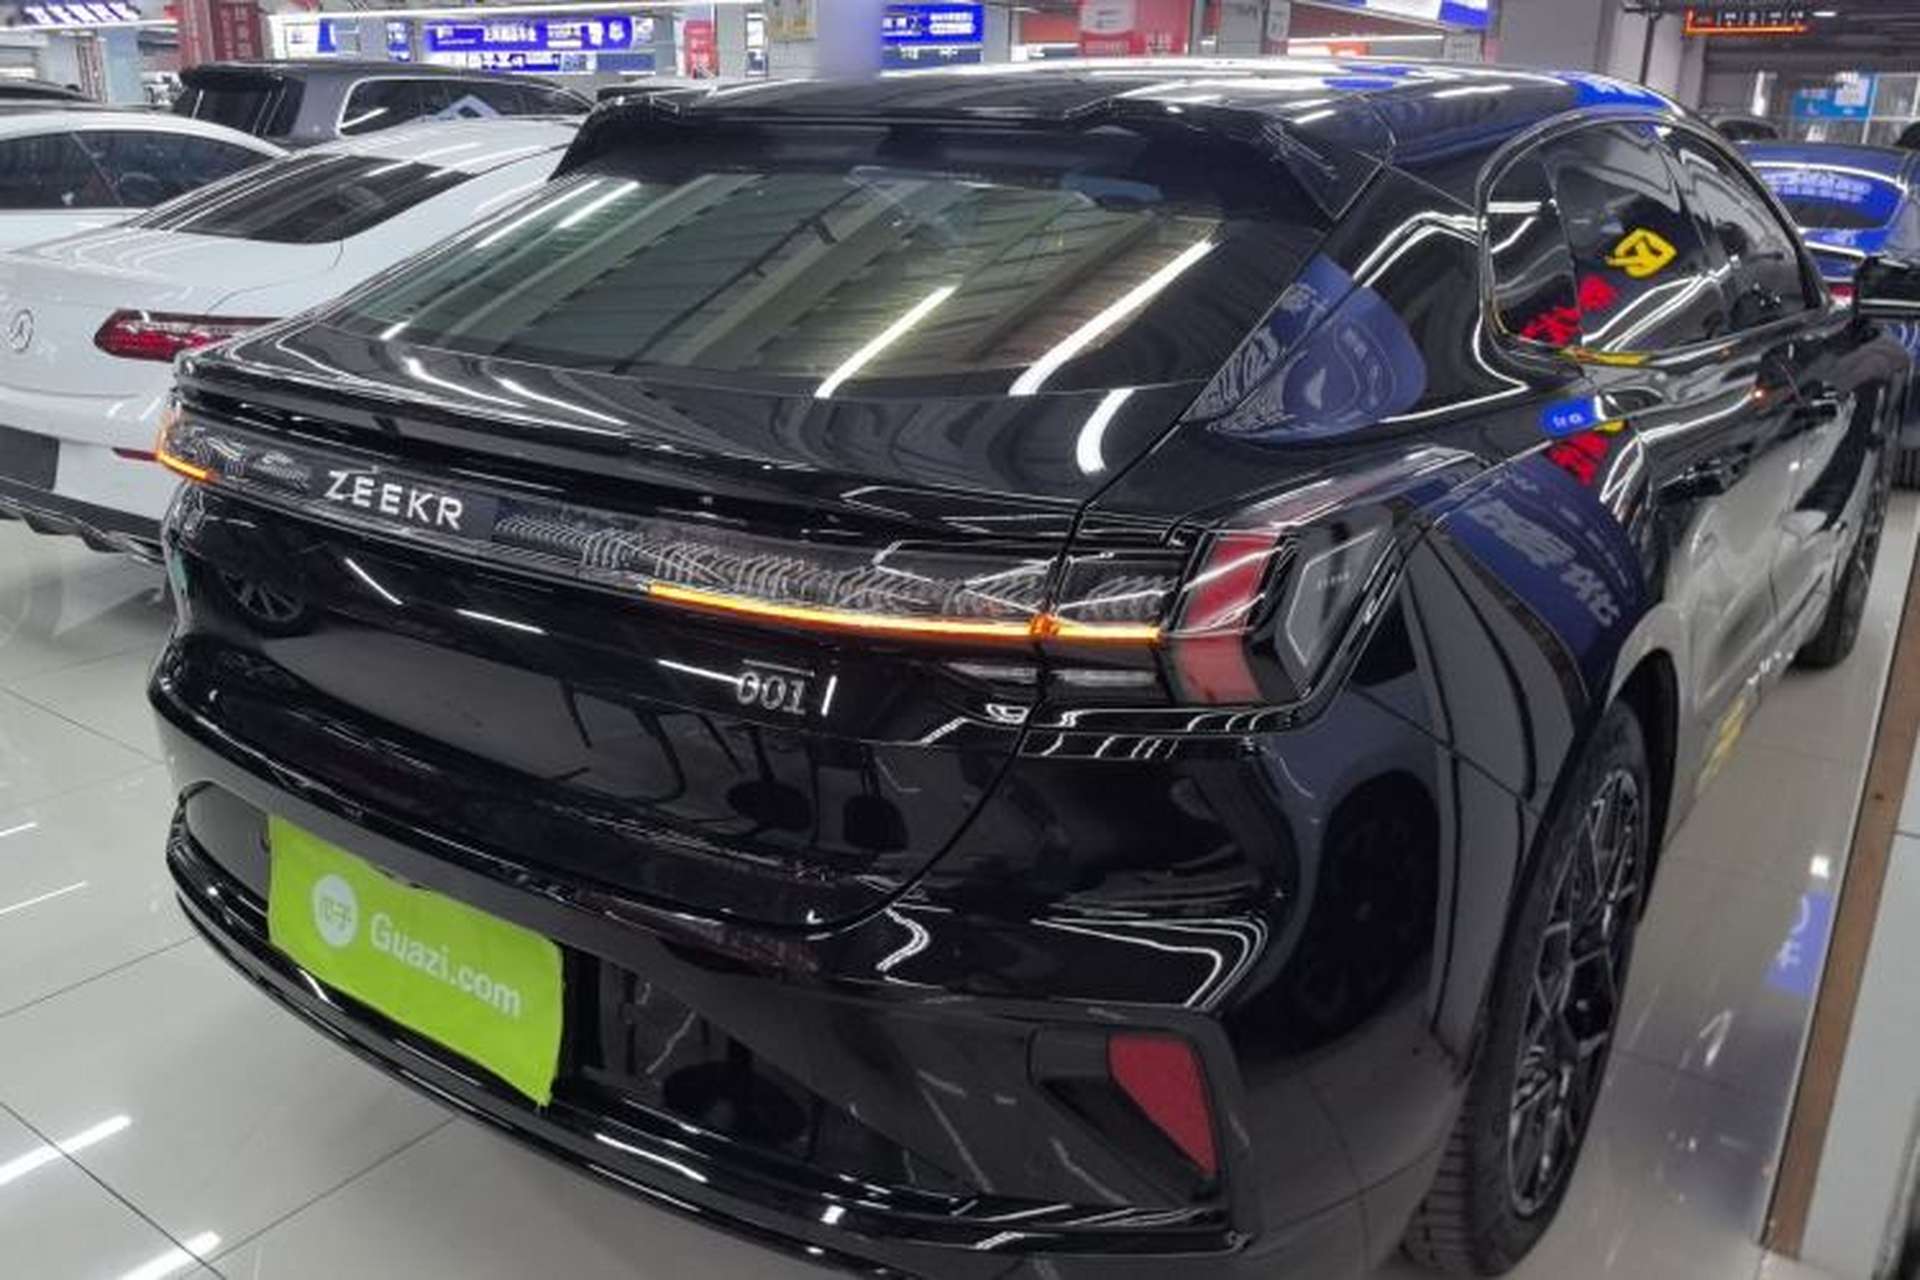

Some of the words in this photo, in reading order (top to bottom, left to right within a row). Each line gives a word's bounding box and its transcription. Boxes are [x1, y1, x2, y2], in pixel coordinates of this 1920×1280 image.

[324, 470, 463, 531] ZEEKR
[737, 671, 806, 715] 001
[370, 912, 521, 1018] Guazi.com
